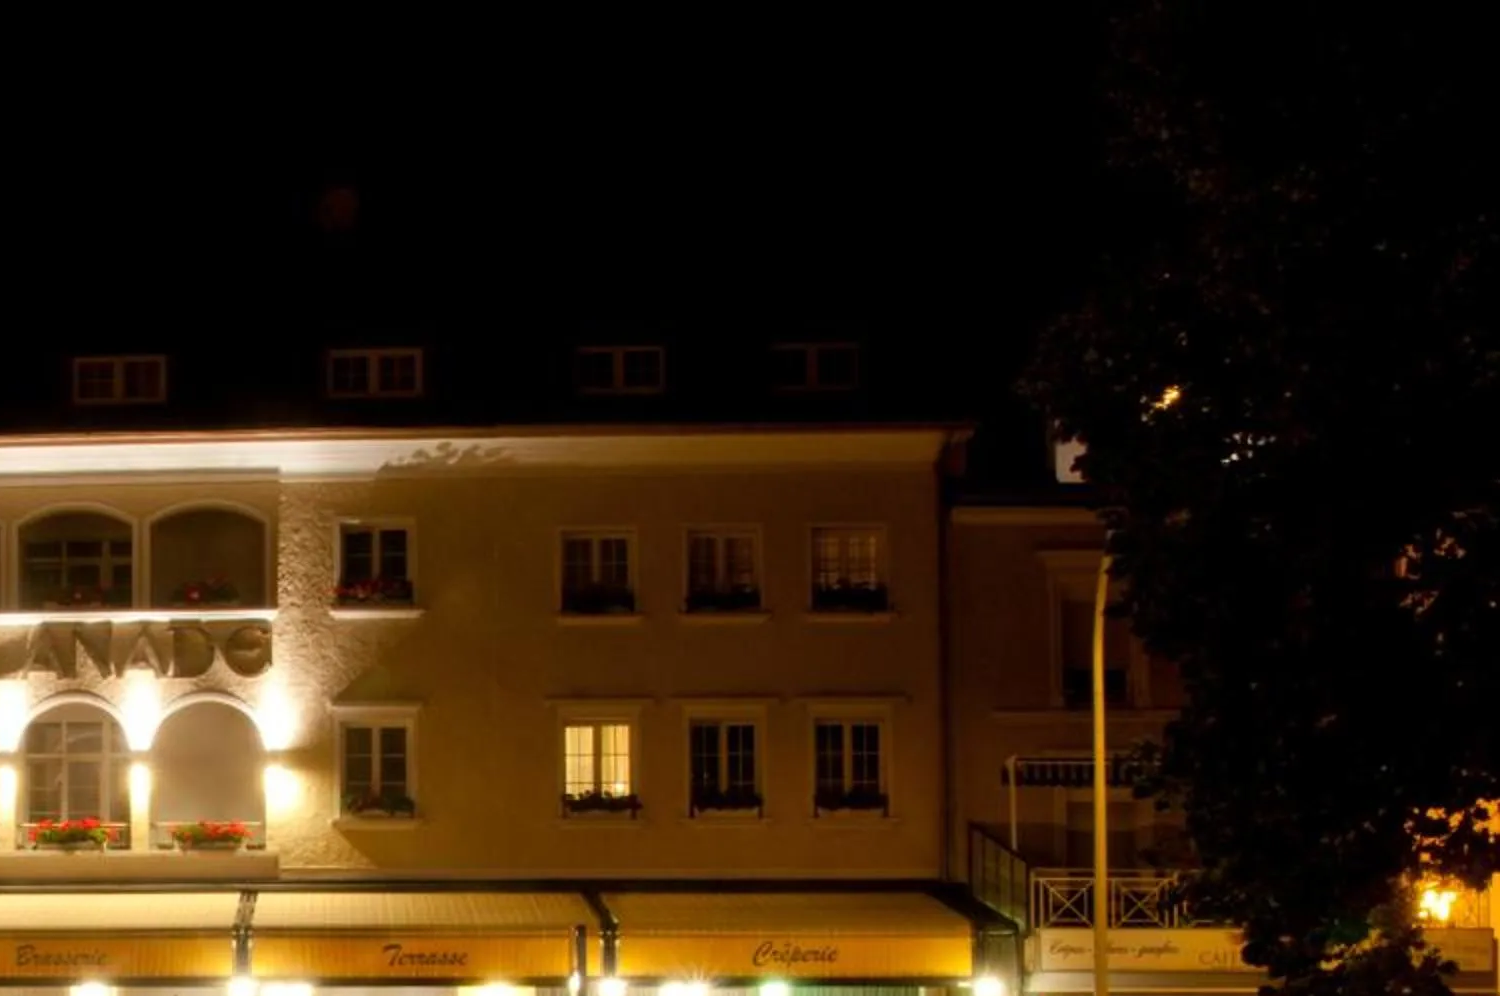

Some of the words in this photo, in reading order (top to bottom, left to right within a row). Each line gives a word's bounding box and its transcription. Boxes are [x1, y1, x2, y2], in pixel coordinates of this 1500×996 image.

[16, 944, 108, 967] Brasserie
[381, 943, 469, 968] Terrasse
[751, 940, 839, 968] Crêperie
